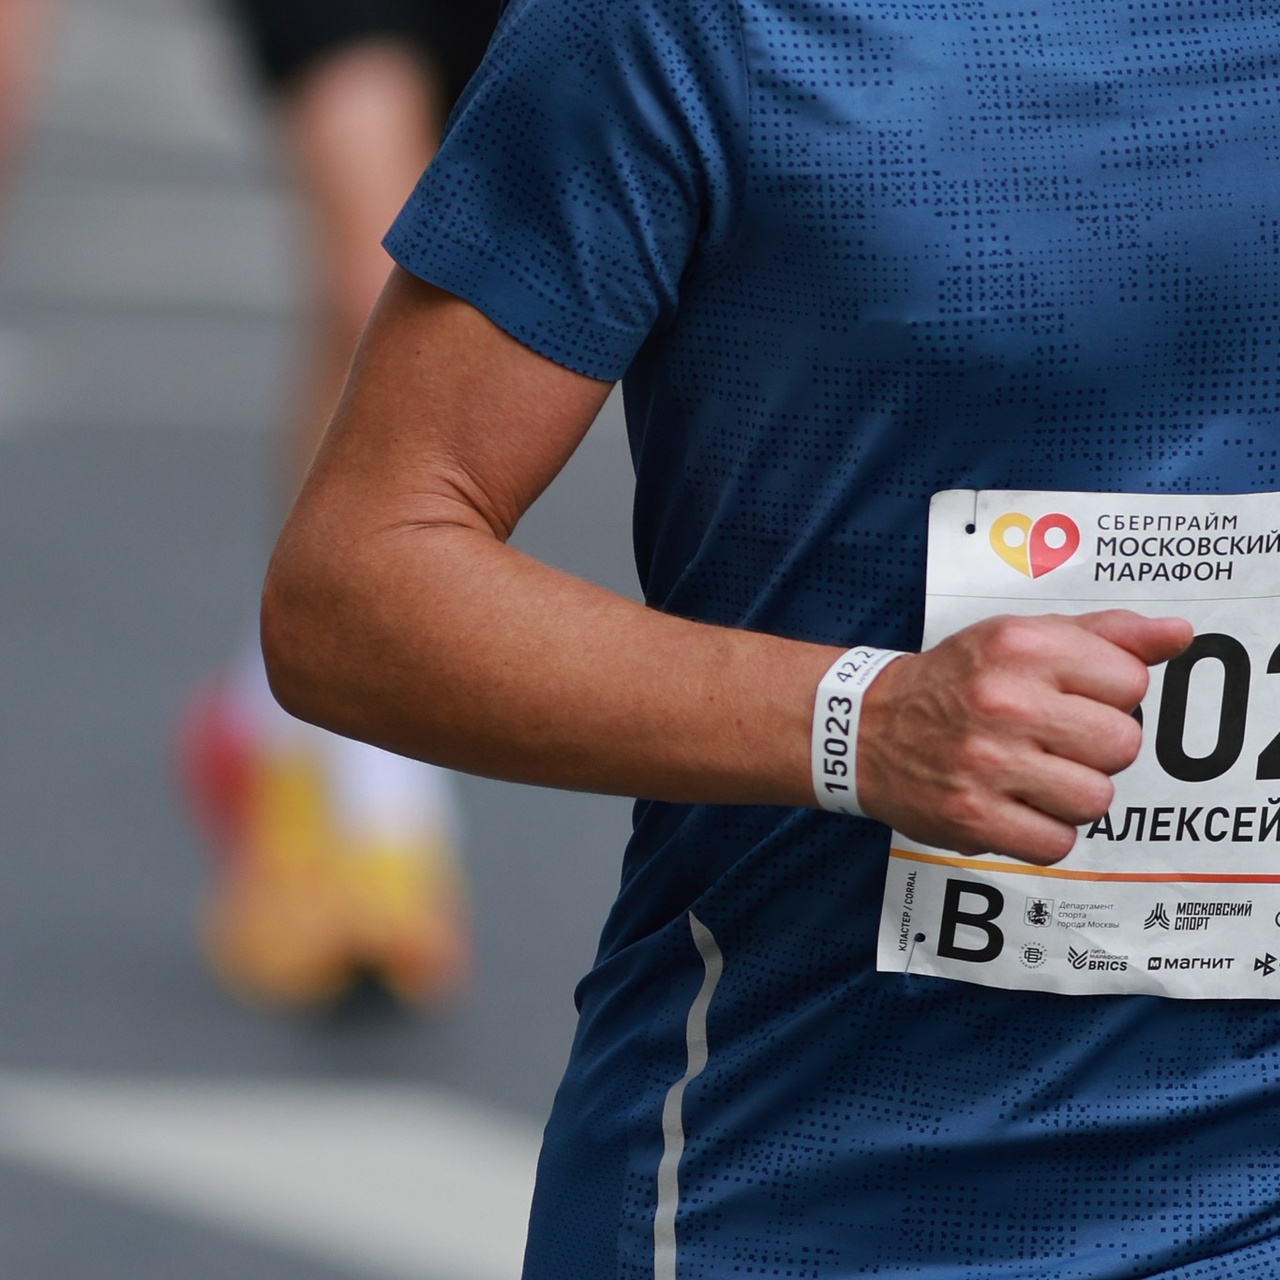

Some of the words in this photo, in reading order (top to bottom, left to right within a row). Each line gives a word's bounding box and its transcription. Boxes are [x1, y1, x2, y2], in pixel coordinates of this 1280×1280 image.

[1097, 512, 1238, 531] СБЕРПРАЙМ
[1094, 561, 1234, 582] МАРАФОН
[823, 695, 852, 794] 15023
[899, 911, 911, 952] КЛАСТЕР
[905, 870, 917, 905] CORRAL
[1059, 901, 1114, 910] Департамент
[1176, 900, 1252, 917] МОСКОВСКИЙ
[937, 878, 1004, 963] B
[1058, 911, 1087, 919] спорта
[1174, 917, 1210, 930] СПОРТ
[1088, 960, 1128, 971] BRICS
